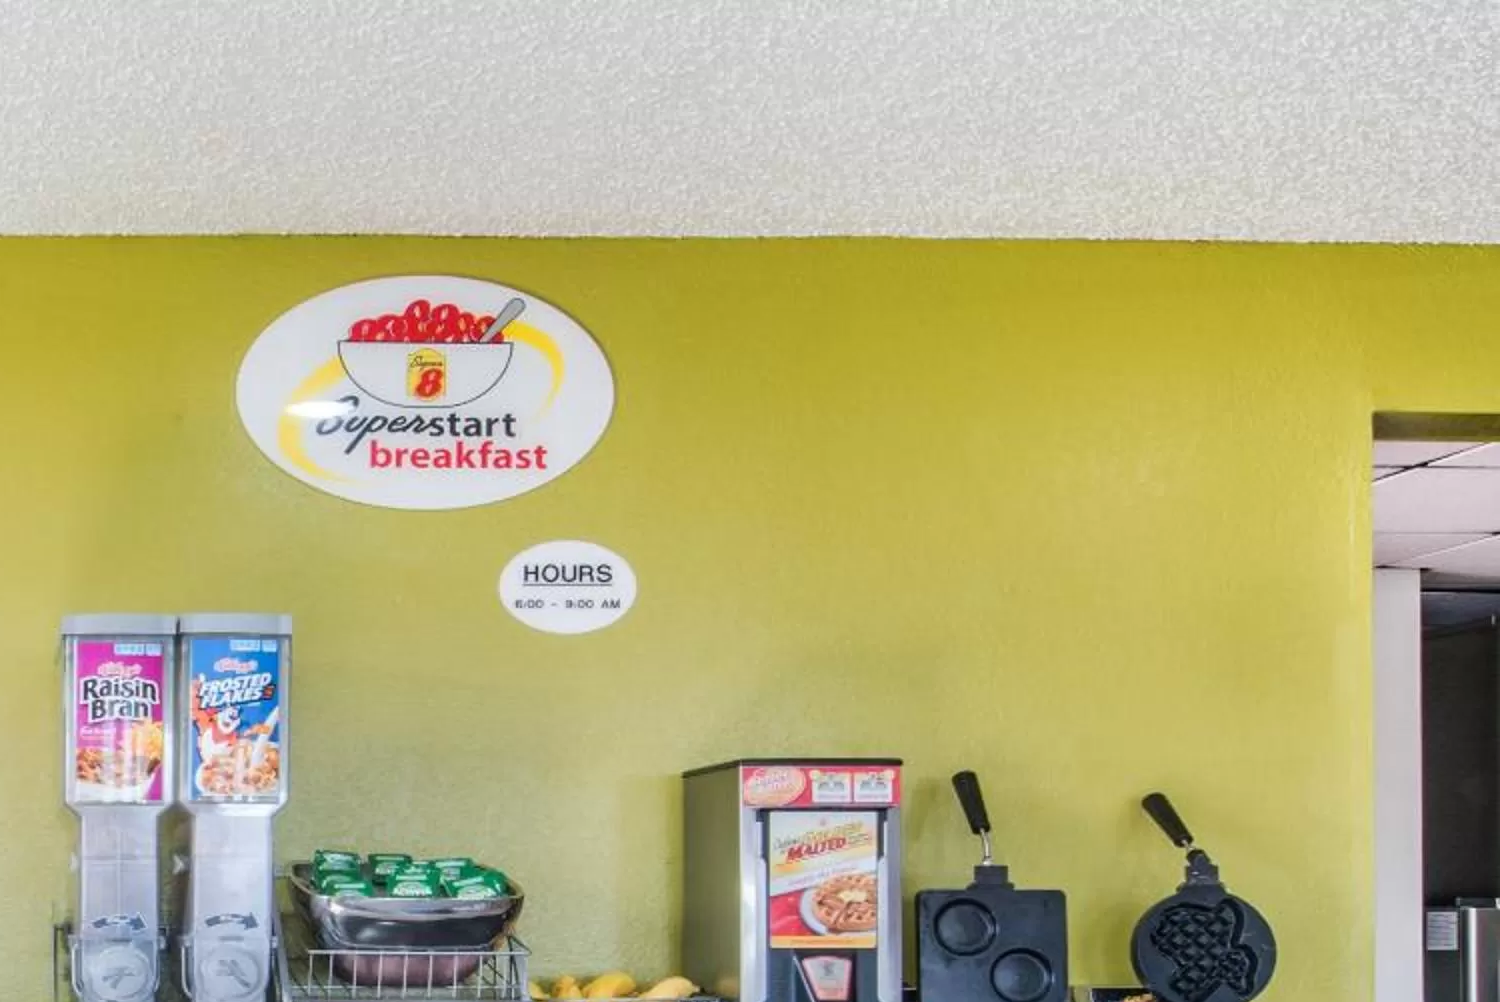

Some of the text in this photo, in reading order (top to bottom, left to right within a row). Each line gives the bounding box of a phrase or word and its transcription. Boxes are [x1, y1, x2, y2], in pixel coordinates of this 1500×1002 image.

[415, 368, 444, 397] 8
[369, 439, 548, 469] breakfast
[523, 563, 613, 583] HOURS
[565, 599, 595, 609] 9:00
[601, 599, 621, 609] AM
[82, 678, 157, 701] Raisin
[200, 672, 272, 696] FROSTED
[201, 687, 263, 708] FLAKES
[90, 699, 149, 721] Bran
